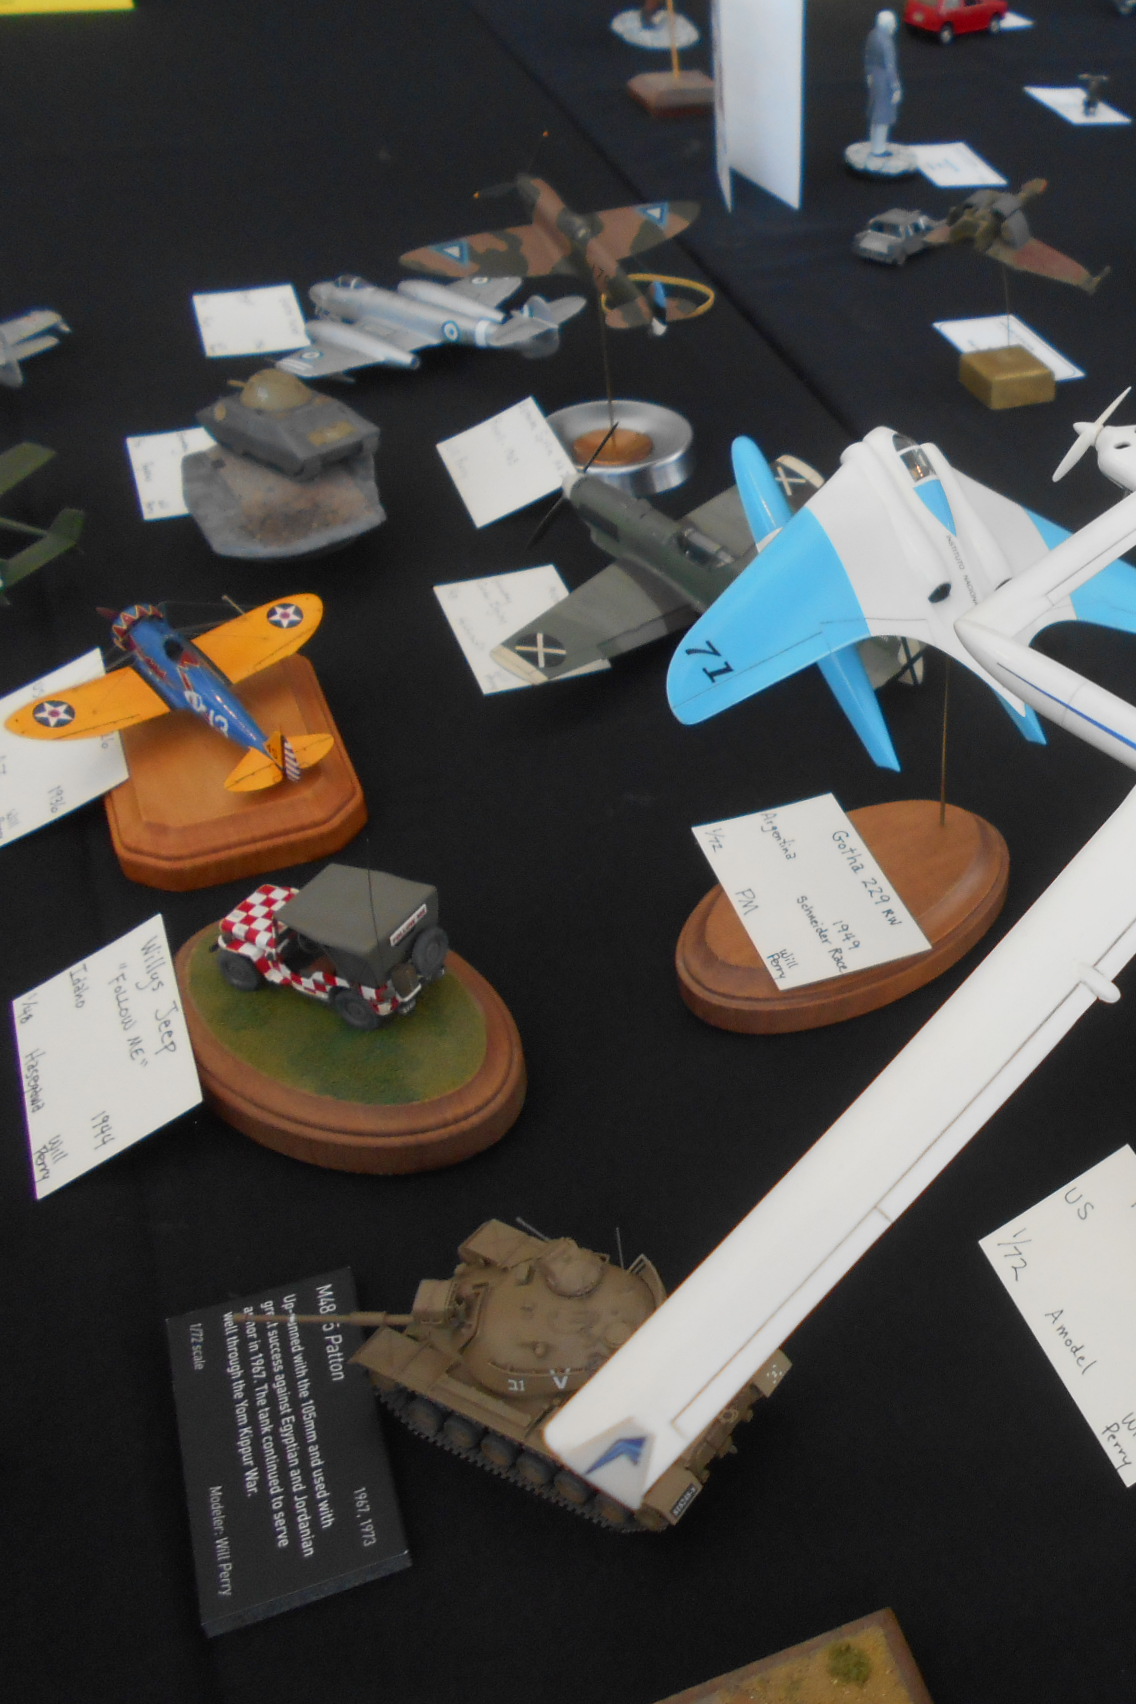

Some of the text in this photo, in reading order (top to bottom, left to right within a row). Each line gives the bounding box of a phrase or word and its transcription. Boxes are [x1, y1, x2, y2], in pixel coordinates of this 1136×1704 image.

[685, 640, 734, 683] 71
[705, 828, 724, 852] 1/72
[760, 813, 796, 860] Argentina
[832, 830, 864, 874] Gotha
[862, 878, 890, 904] 229
[736, 888, 759, 916] PM
[797, 896, 847, 972] Schneider Race
[832, 920, 860, 950] 1949
[767, 952, 785, 979] Perry
[779, 949, 798, 968] Will
[20, 994, 37, 1024] 1/48
[69, 963, 87, 1008] Idaho
[135, 935, 179, 1055] Willys Jeep
[48, 1134, 68, 1164] Will
[91, 1111, 115, 1150] 1944
[1064, 1187, 1094, 1220] US
[997, 1228, 1032, 1282] 1/72
[312, 1283, 349, 1380] M485 Patton
[190, 1342, 206, 1372] scale
[220, 1310, 261, 1498] well through the Yom Kippur War.
[240, 1304, 288, 1549] amor in 1967. The tank continued to serve
[278, 1292, 336, 1530] Up-nned with the 105mm and used with
[259, 1298, 317, 1558] gret success against Egyptian and Jordanian
[1102, 1422, 1132, 1474] Perry
[207, 1482, 232, 1595] Modeler: Will Perry
[354, 1487, 376, 1546] 1967, 1973
